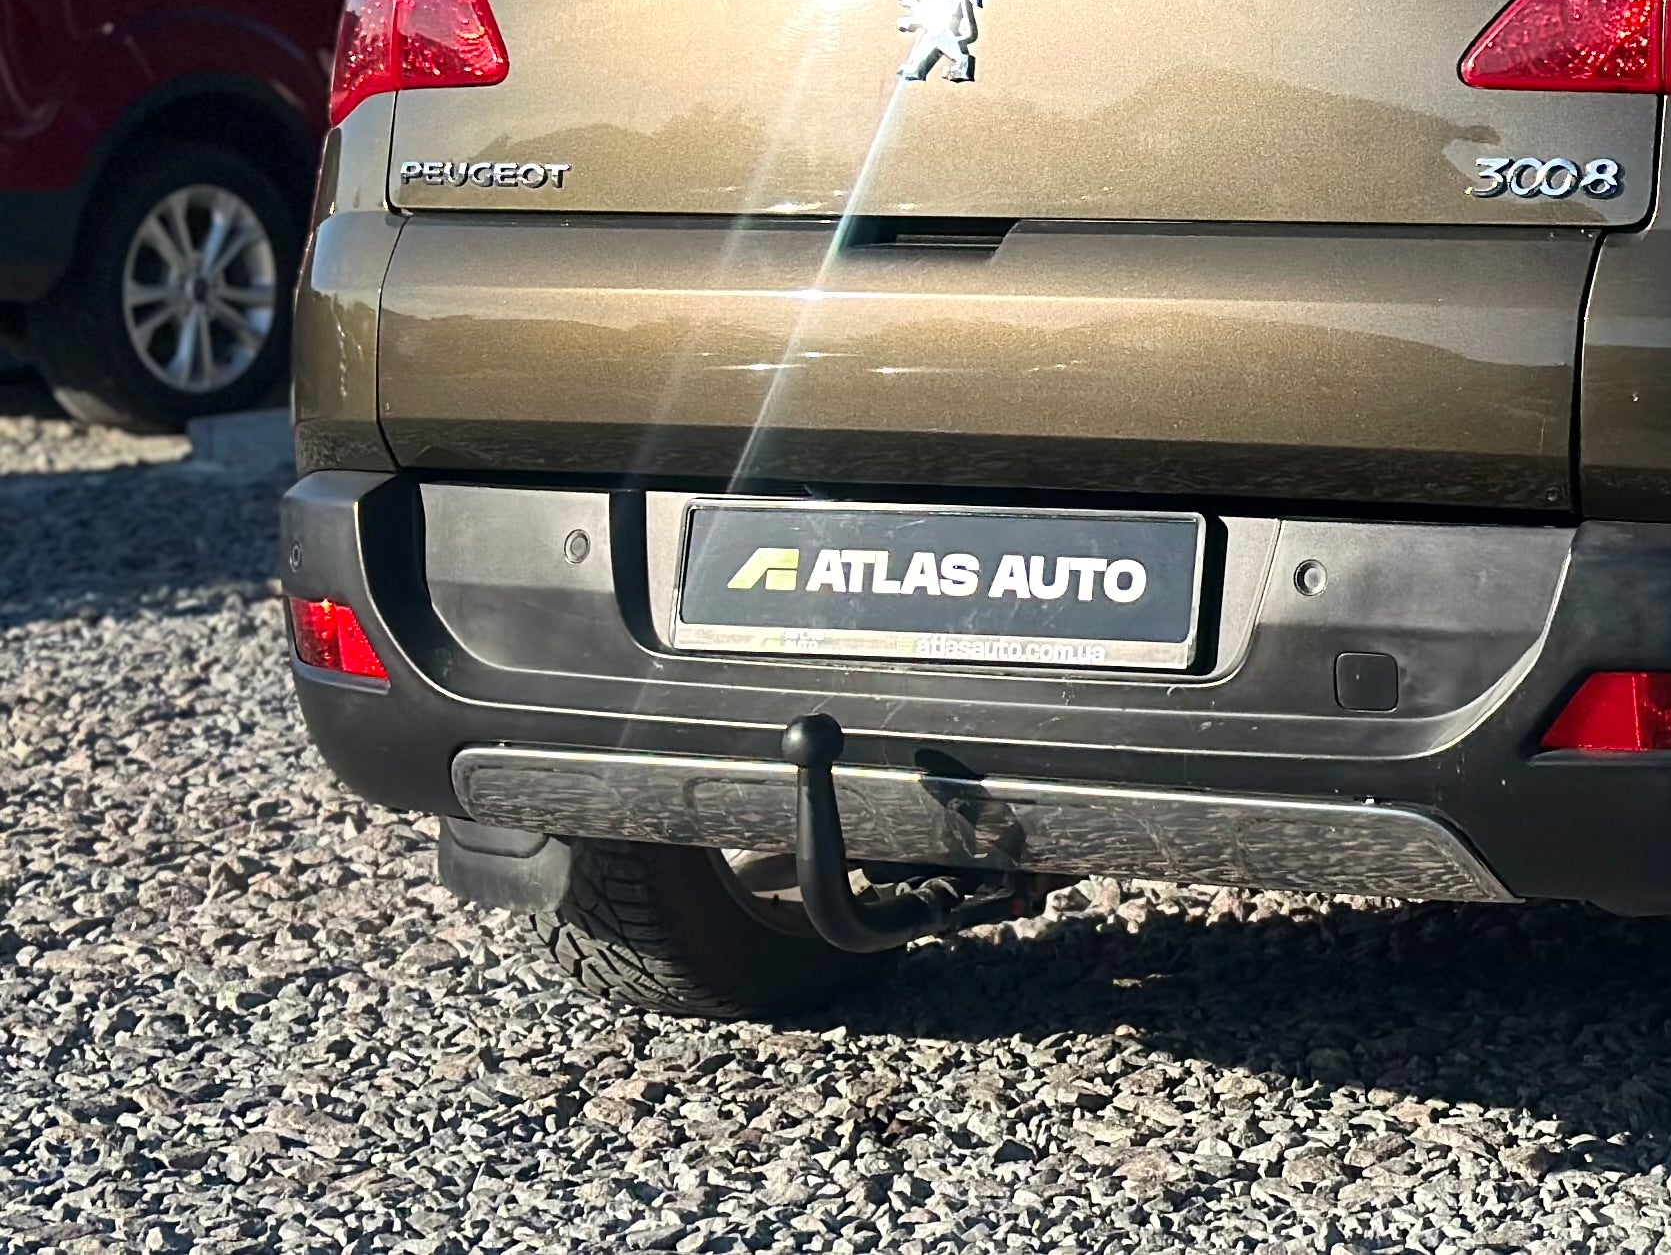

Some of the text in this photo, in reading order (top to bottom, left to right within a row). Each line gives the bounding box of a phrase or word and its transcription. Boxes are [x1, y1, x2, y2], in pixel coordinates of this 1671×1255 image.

[400, 161, 572, 188] PEUGEOT
[1464, 157, 1622, 198] 3008
[806, 548, 1147, 603] ATLAS AUTO
[916, 636, 1105, 664] atlasauto.com.ua
